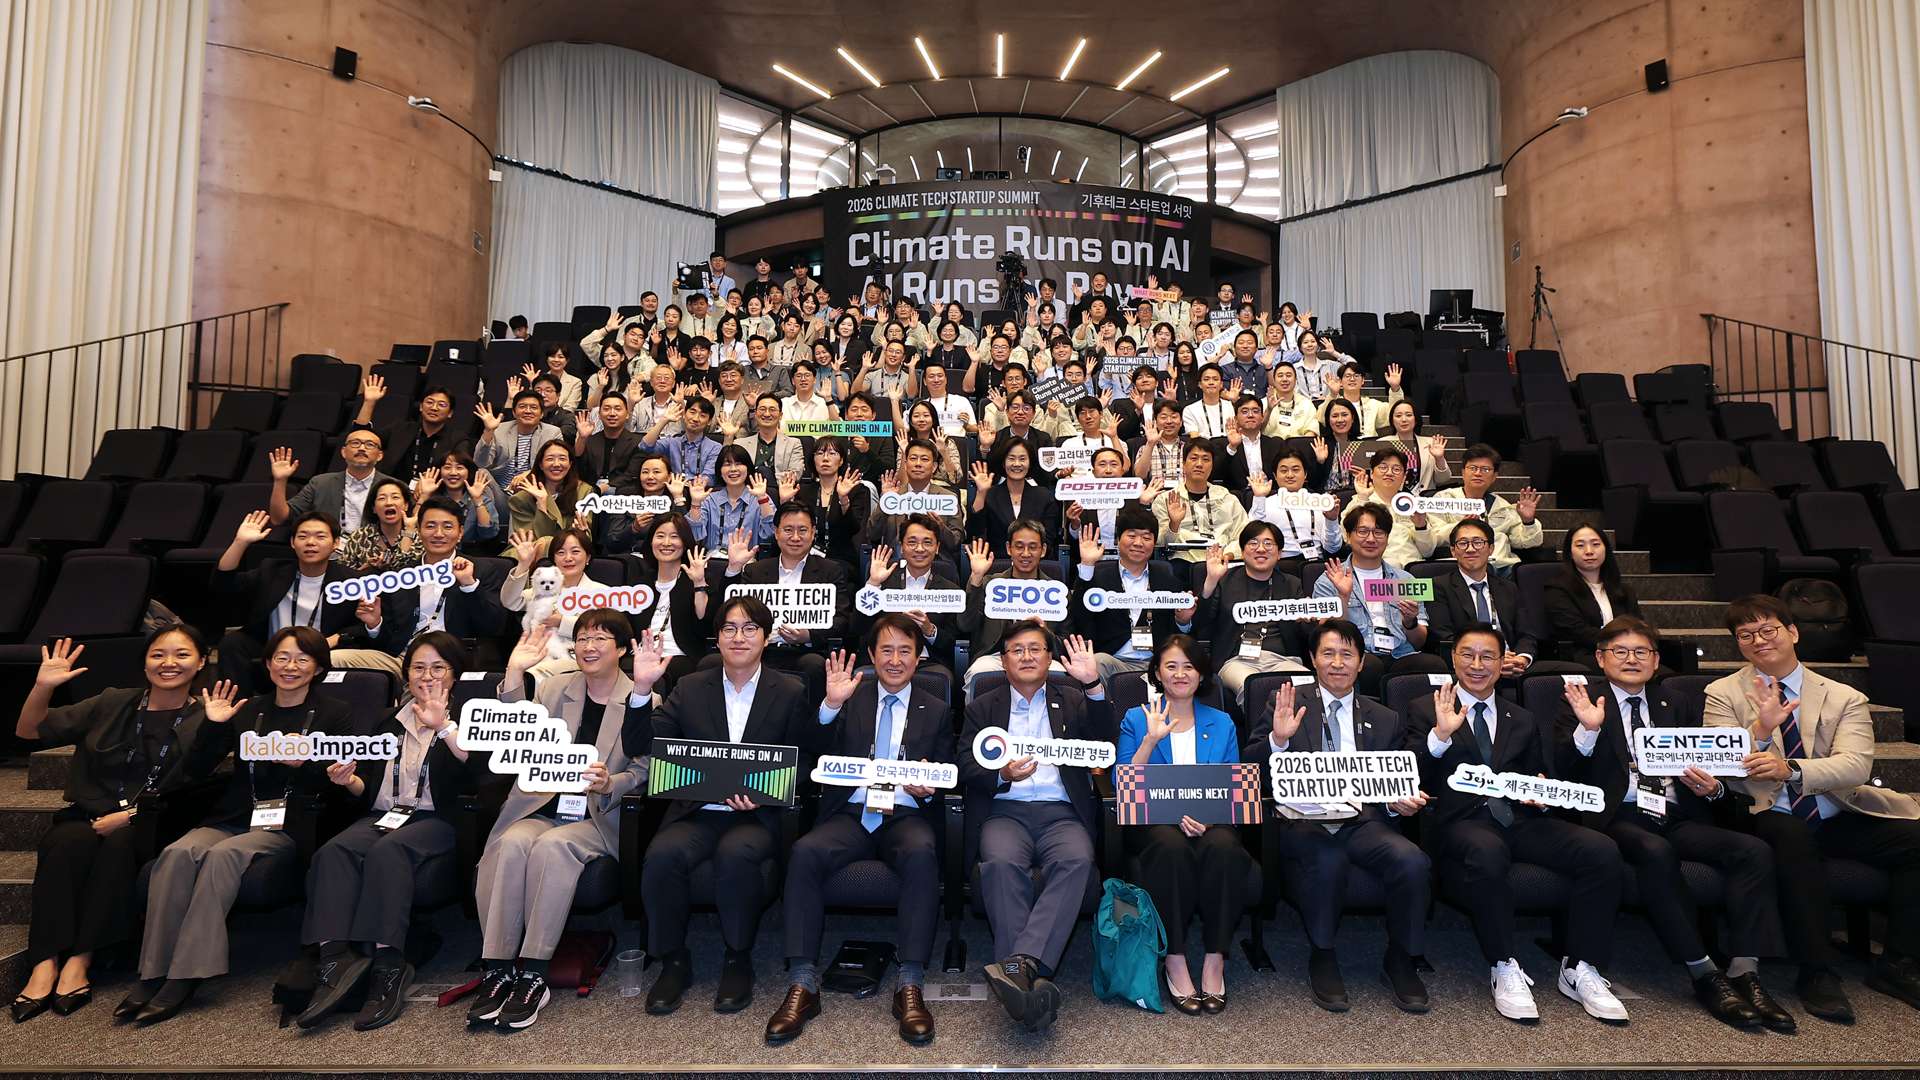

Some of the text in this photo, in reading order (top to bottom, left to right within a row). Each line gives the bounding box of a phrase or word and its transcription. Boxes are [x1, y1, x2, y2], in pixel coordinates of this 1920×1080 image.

[848, 199, 873, 213] 2026
[875, 193, 918, 209] CLIMATE
[922, 192, 949, 206] TECH
[950, 190, 995, 205] STARTUP
[1082, 194, 1192, 220] 기후테크 스타트업 서밋
[848, 226, 1190, 272] Climate Runs on AI
[902, 272, 1000, 304] Runs
[1210, 310, 1235, 319] CLIMATE
[1104, 356, 1118, 364] 2026
[1120, 357, 1142, 365] CLIMATE
[1032, 380, 1057, 394] Climate
[1060, 390, 1075, 400] Runs
[1075, 384, 1084, 392] on
[1036, 391, 1052, 402] Runs
[1065, 392, 1086, 404] Power
[788, 424, 890, 433] WHY CLIMATE RUNS ON AI
[602, 499, 668, 511] 아산나눔재단
[1280, 491, 1331, 509] kakao
[330, 562, 452, 600] sopoong
[795, 588, 830, 606] TECH
[1370, 583, 1428, 596] RUN DEEP
[562, 590, 648, 611] dcamp
[886, 594, 962, 602] 한국기후에너지산업협회
[1108, 596, 1190, 604] GreenTech Alliance
[1238, 602, 1338, 618] (사)한국기후테크협회
[470, 708, 538, 724] Climate
[468, 726, 560, 744] Runs on AI,
[1644, 735, 1743, 748] KENTECH
[500, 750, 588, 765] AI Runs on
[667, 744, 782, 762] WHY CLIMATE RUNS ON AI
[1012, 744, 1110, 762] 기후에너지환경부
[1646, 752, 1743, 762] 한국에너지공과대학교
[823, 762, 866, 774] KAIST
[876, 764, 952, 782] 한국과학기술원
[1276, 756, 1412, 774] 2026 CLIMATE TECH
[528, 768, 583, 782] Power
[1463, 770, 1494, 788] Jeju
[1150, 788, 1228, 800] WHAT RUNS NEXT
[1278, 778, 1346, 798] STARTUP
[1504, 779, 1598, 806] 제주특별자치도
